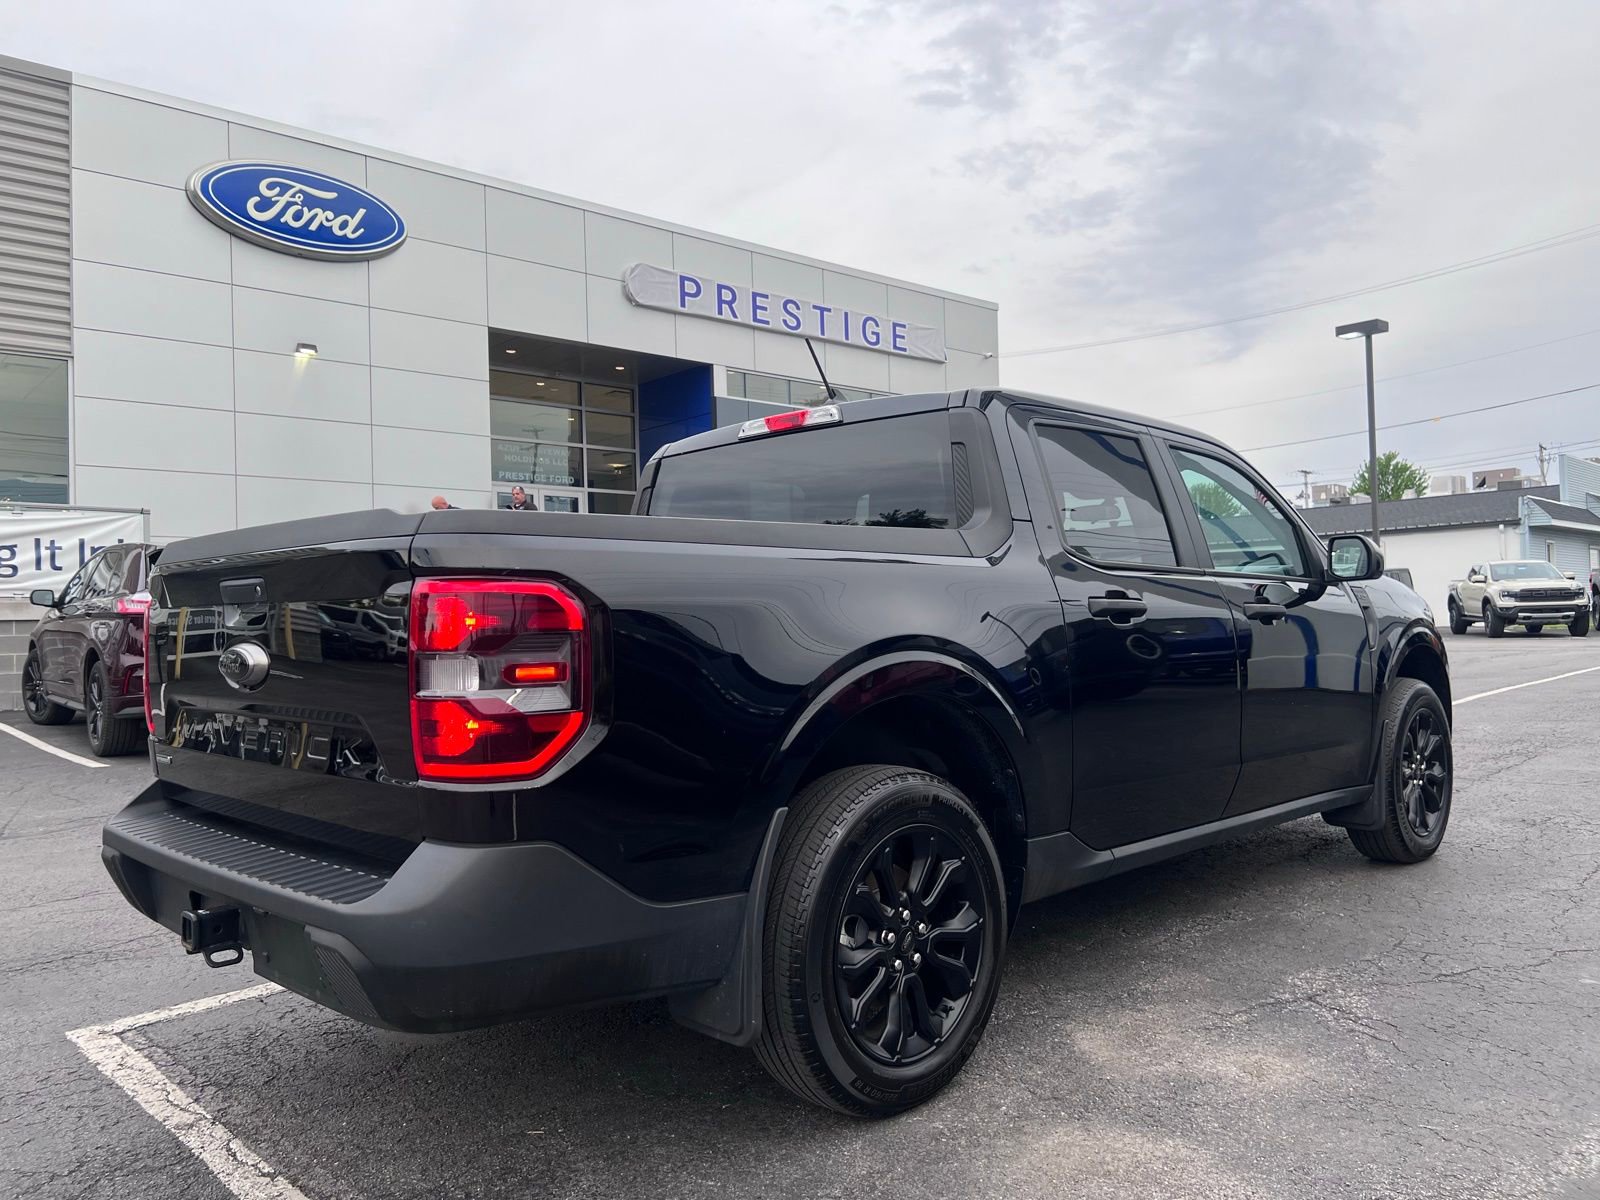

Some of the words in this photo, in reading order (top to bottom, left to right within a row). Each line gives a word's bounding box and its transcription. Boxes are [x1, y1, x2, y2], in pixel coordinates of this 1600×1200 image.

[246, 177, 367, 240] Ford
[678, 273, 909, 353] PRESTIGE
[498, 471, 547, 483] PRESTIGE
[549, 474, 575, 486] FORD
[34, 537, 64, 571] It
